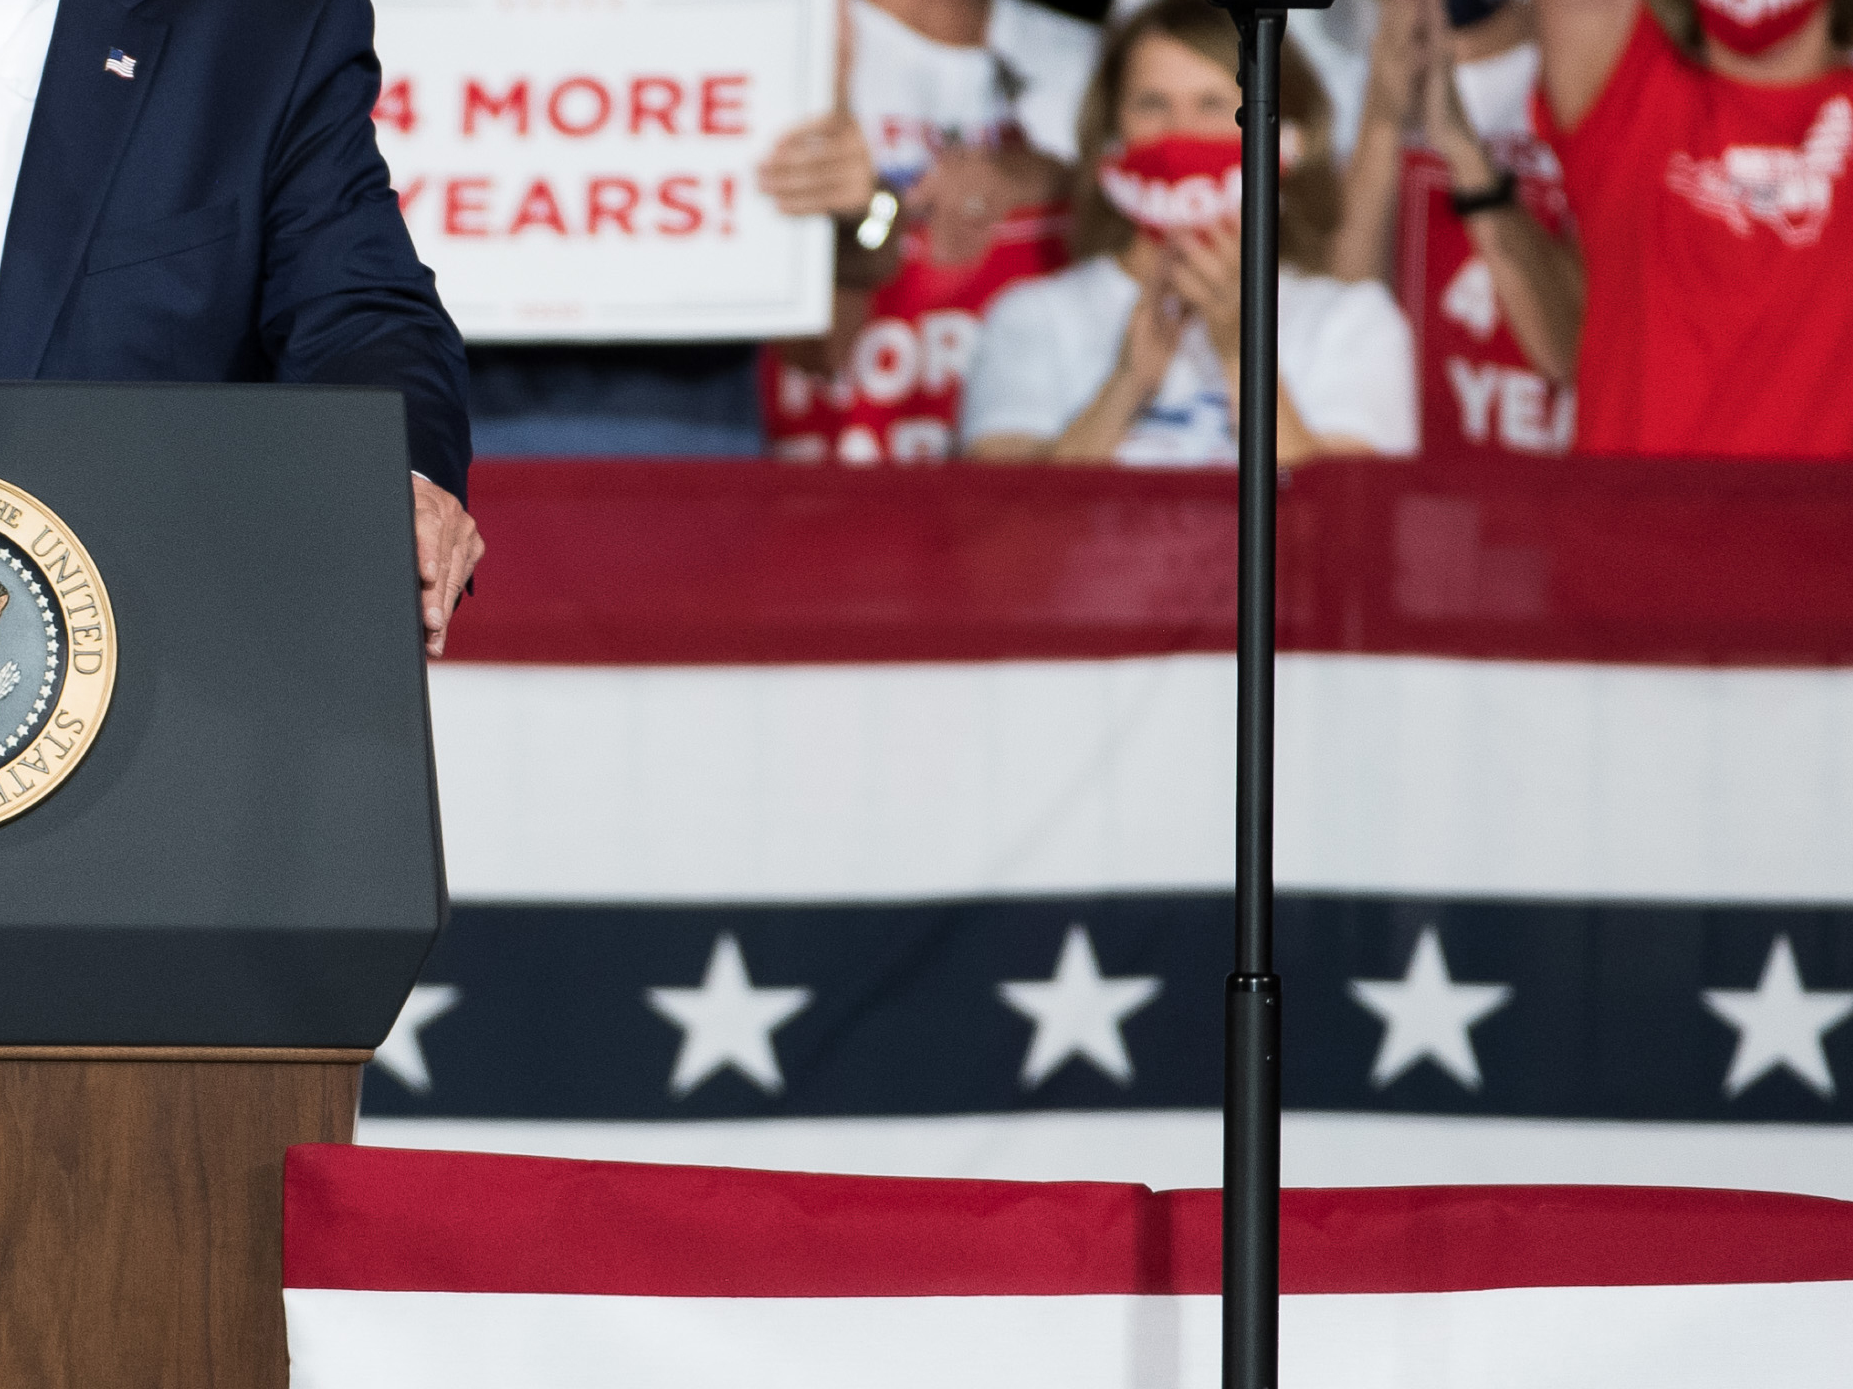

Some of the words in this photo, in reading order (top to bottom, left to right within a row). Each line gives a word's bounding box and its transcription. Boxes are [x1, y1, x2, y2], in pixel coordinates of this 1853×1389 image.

[370, 73, 418, 136] 4
[459, 73, 754, 138] MORE
[1442, 259, 1497, 343] 4
[32, 524, 104, 676] UNITED
